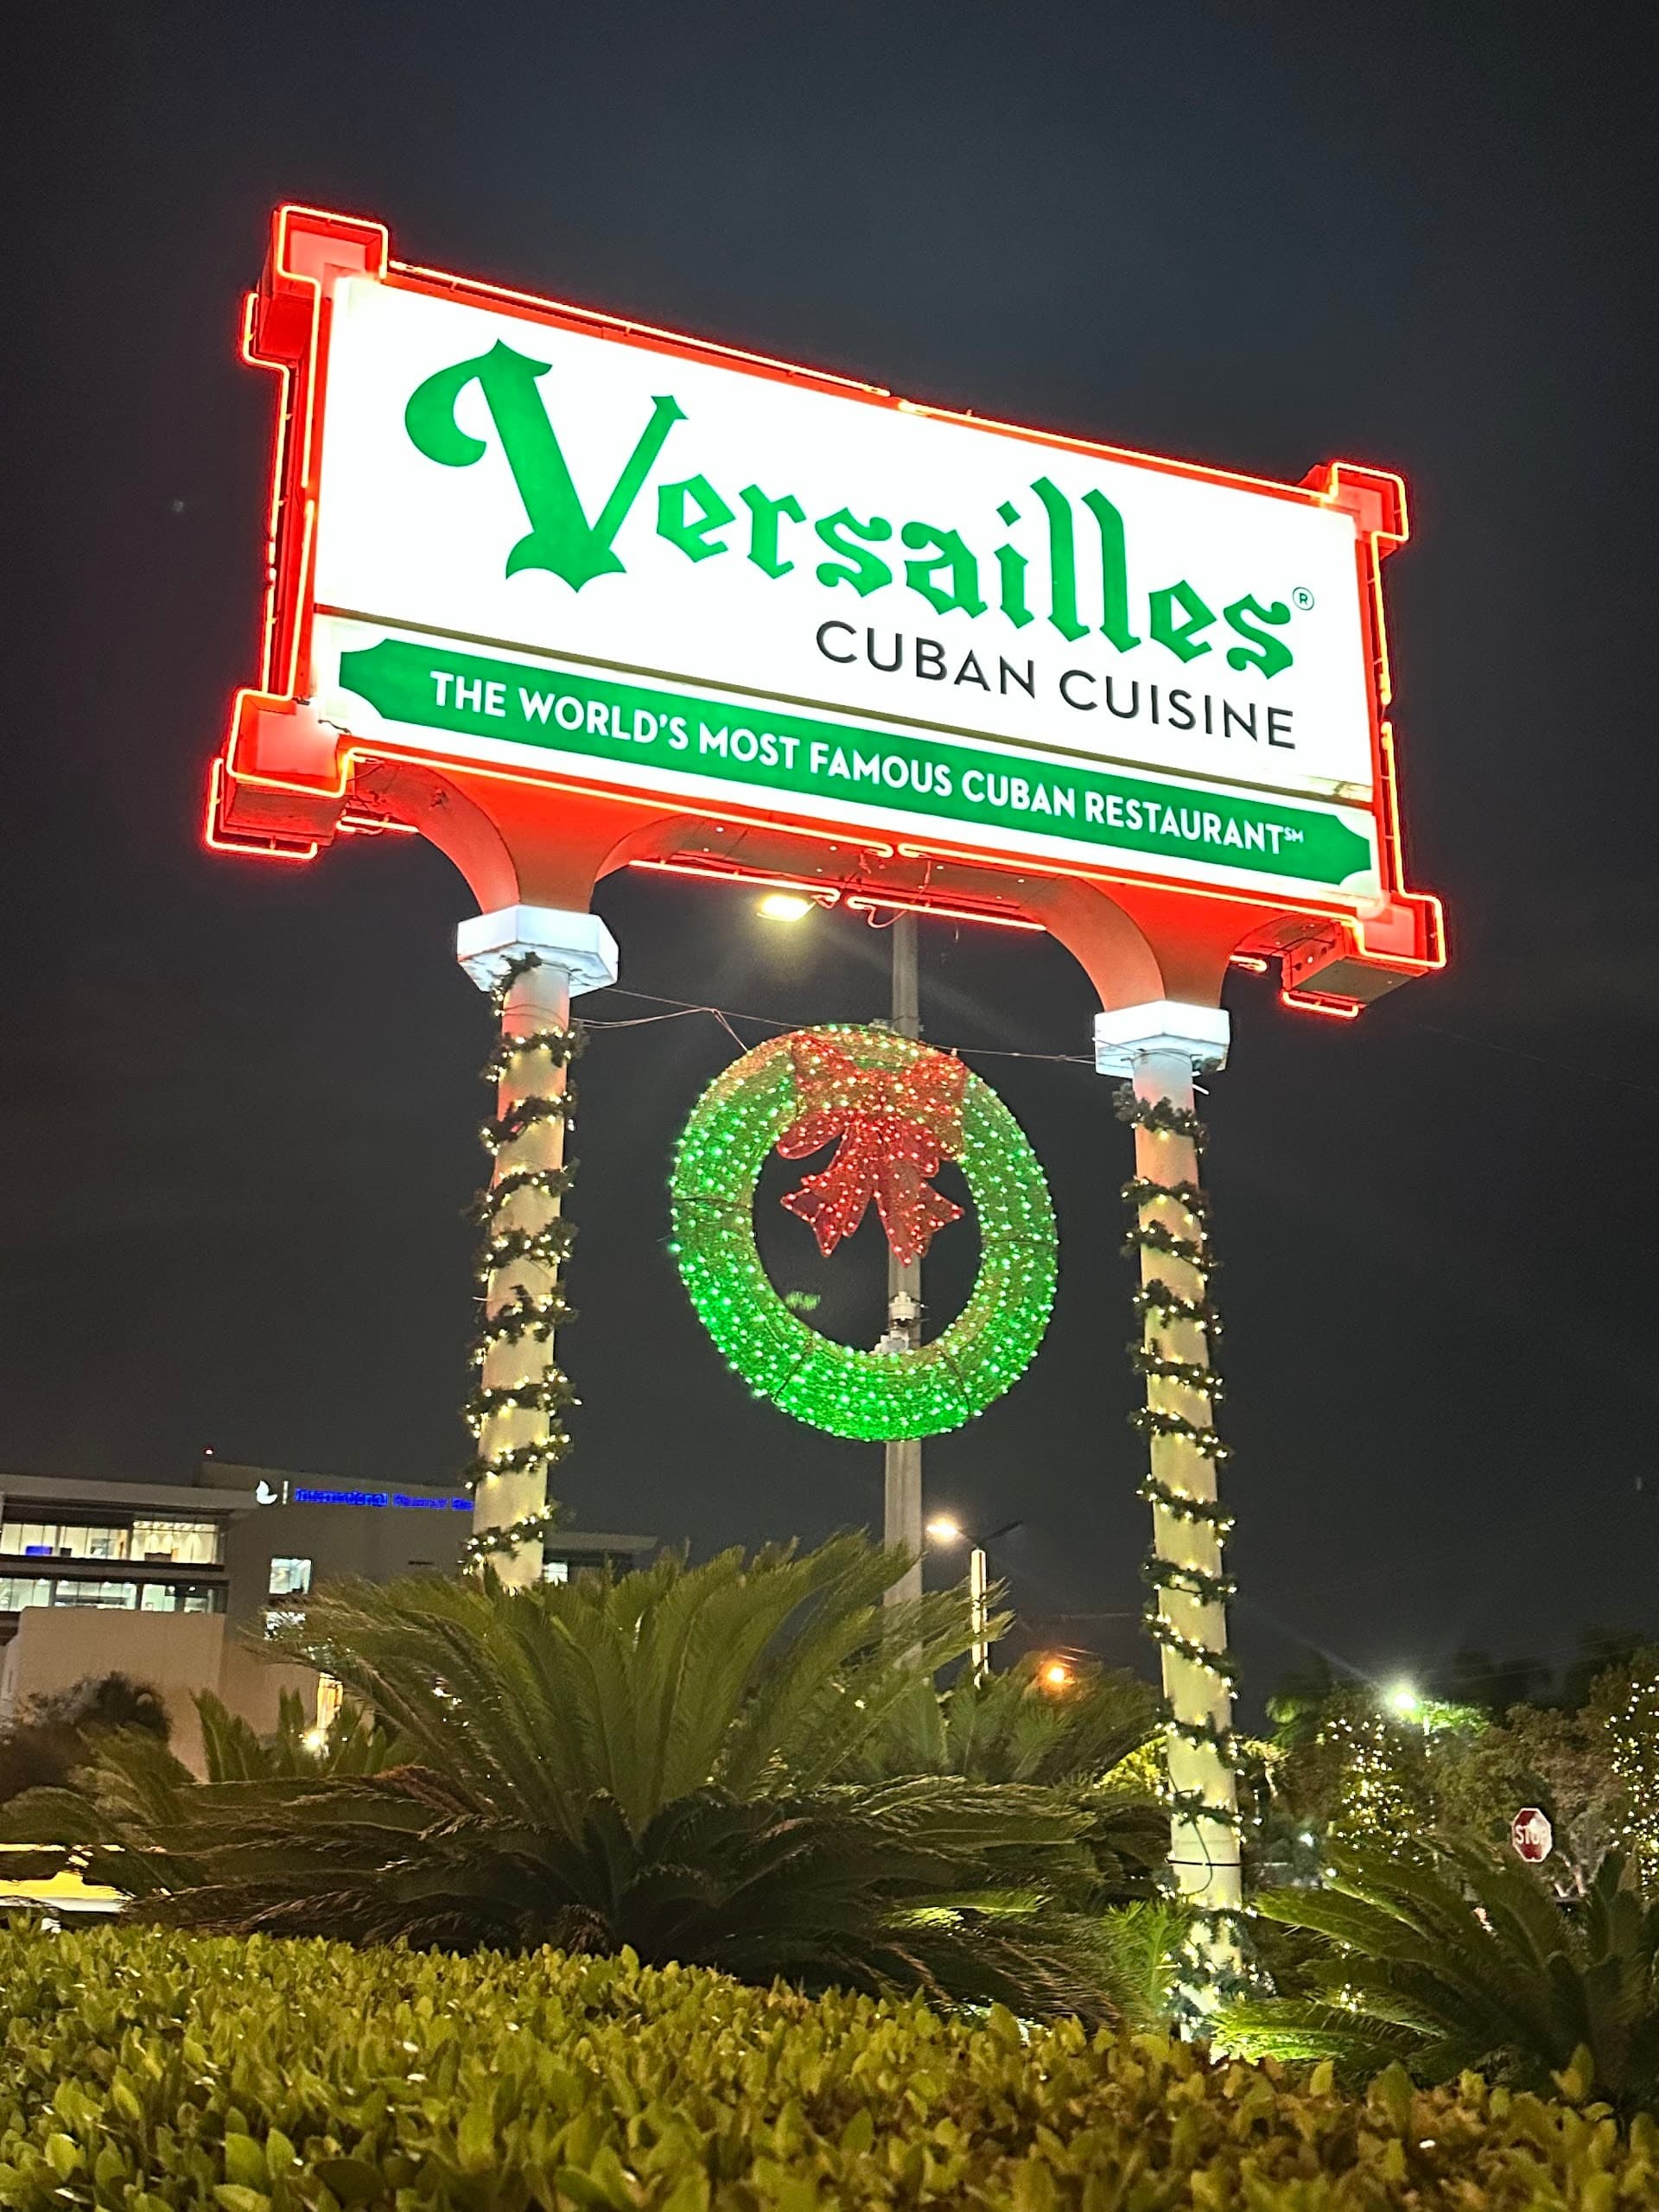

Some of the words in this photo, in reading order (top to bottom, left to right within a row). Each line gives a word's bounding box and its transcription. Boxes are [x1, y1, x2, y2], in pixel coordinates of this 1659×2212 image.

[404, 338, 1294, 680] Versailles
[429, 671, 507, 718] THE
[518, 687, 690, 751] WORLD'S
[699, 722, 800, 769] MOST
[810, 741, 953, 797] FAMOUS
[962, 770, 1077, 817] CUBAN
[816, 620, 1035, 699] CUBAN
[1058, 669, 1296, 749] CUISINE
